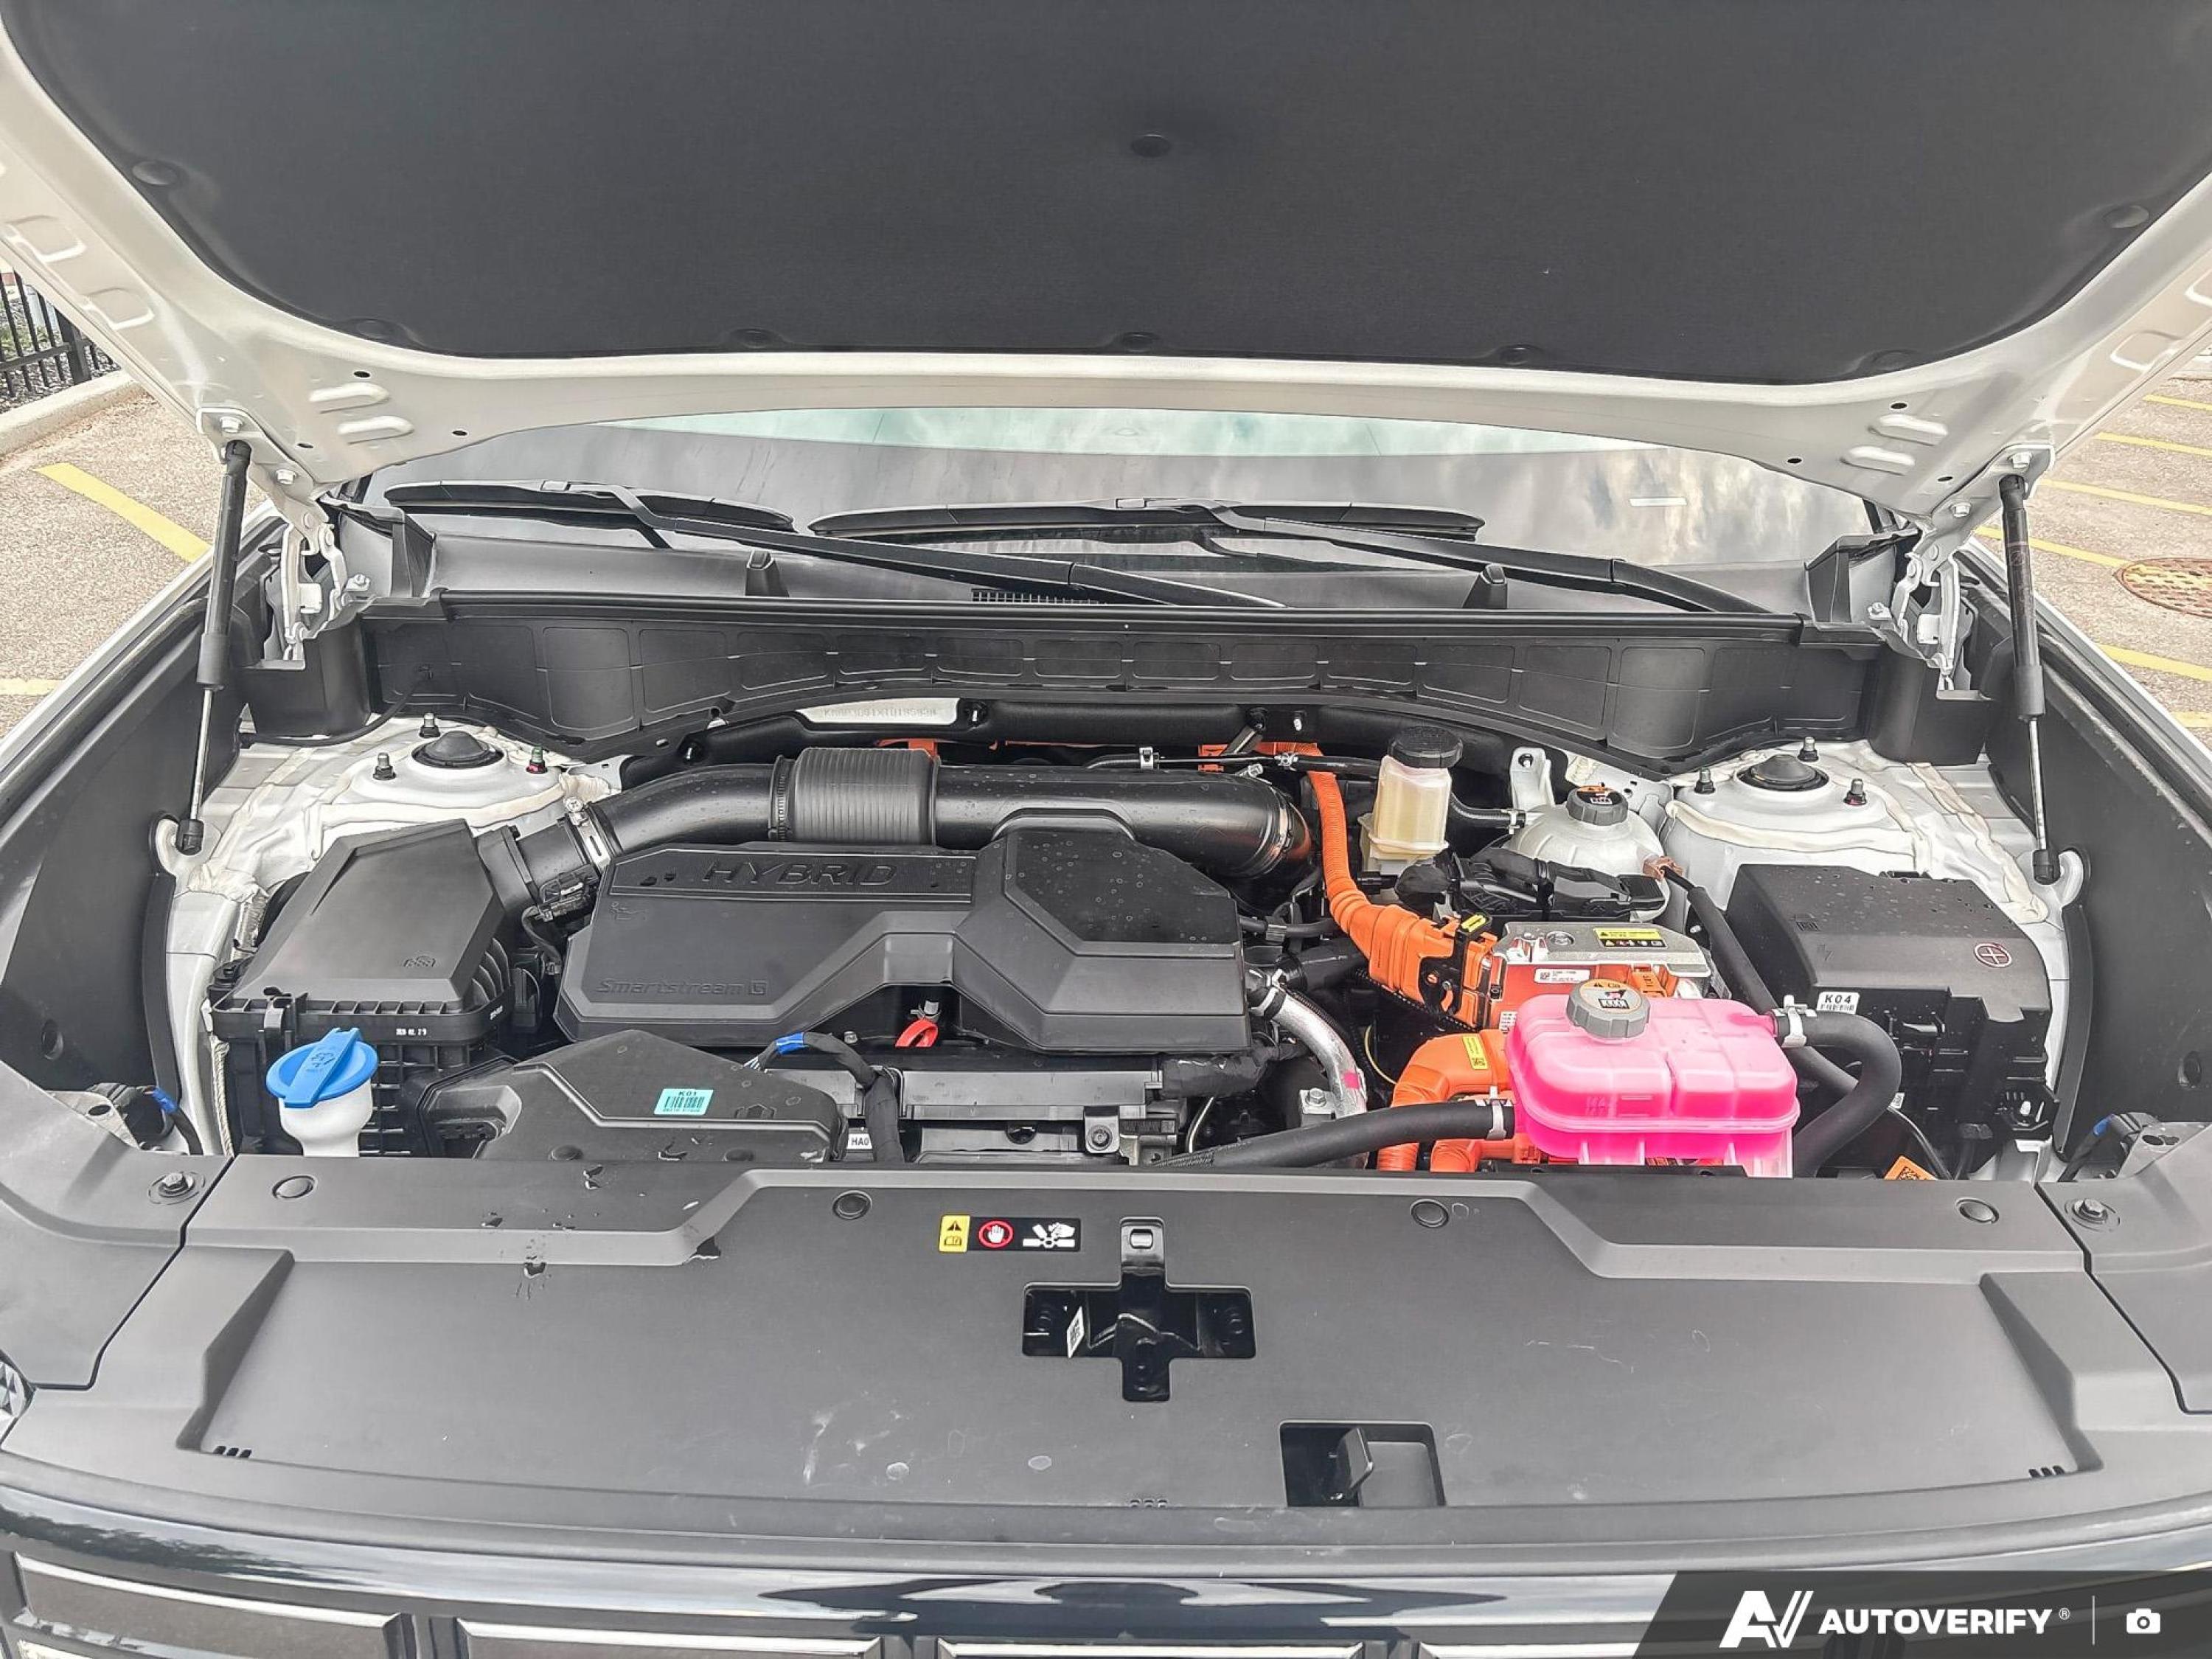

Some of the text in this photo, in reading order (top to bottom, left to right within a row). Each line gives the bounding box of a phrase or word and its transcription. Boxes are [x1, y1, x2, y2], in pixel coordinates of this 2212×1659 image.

[702, 861, 897, 886] HYBRID
[596, 978, 745, 995] Smartstream
[1824, 995, 1852, 1004] K04
